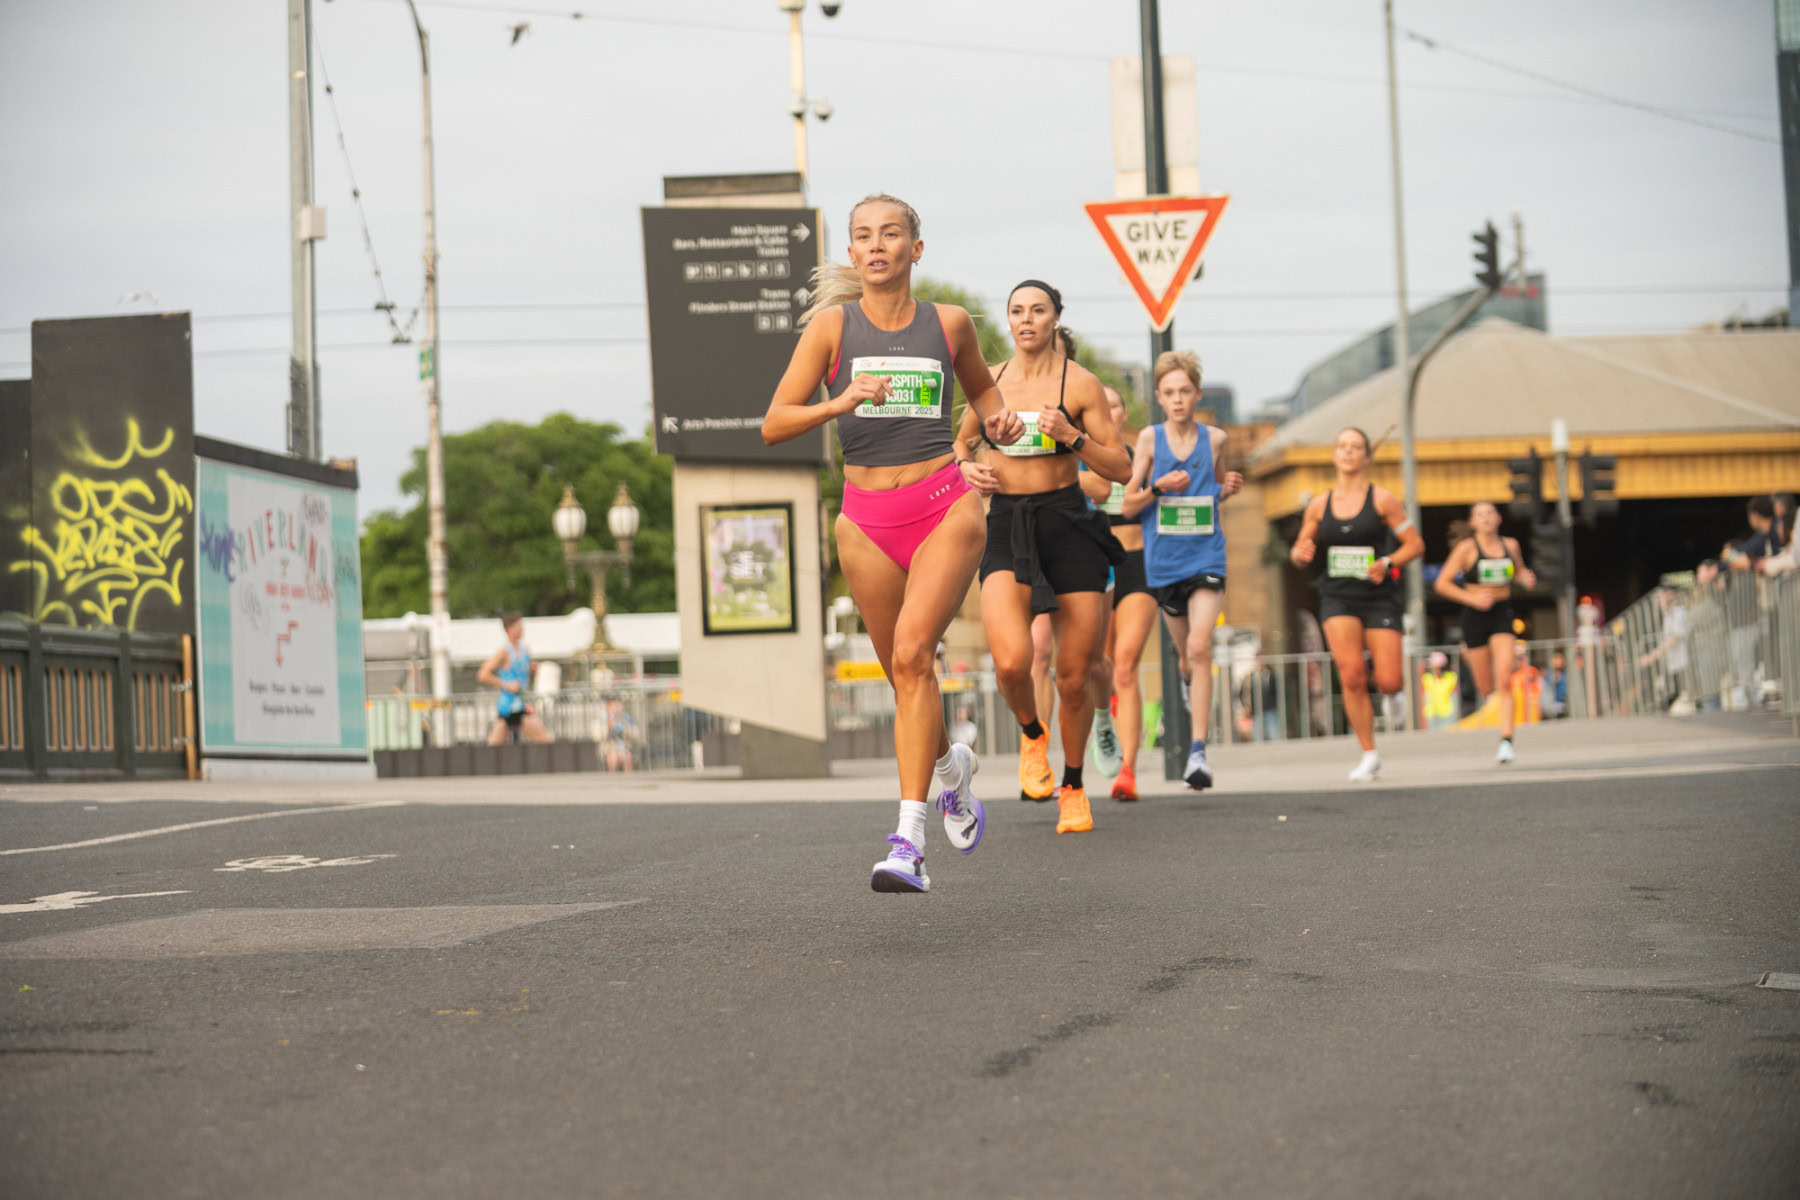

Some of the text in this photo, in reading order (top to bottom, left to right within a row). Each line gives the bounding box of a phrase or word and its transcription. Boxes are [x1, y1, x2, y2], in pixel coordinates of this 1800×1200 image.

[731, 224, 788, 237] Main Square
[1127, 219, 1188, 243] GIVE
[698, 237, 755, 249] Restaurants
[757, 246, 789, 257] Toilets
[1137, 247, 1180, 265] WAY
[760, 288, 790, 299] Trams
[688, 299, 791, 313] Flinders Street Station
[862, 406, 934, 415] MELBOURNE 2025
[682, 418, 704, 430] Arts
[704, 417, 742, 430] Precinct
[236, 507, 328, 582] RIVERLAND
